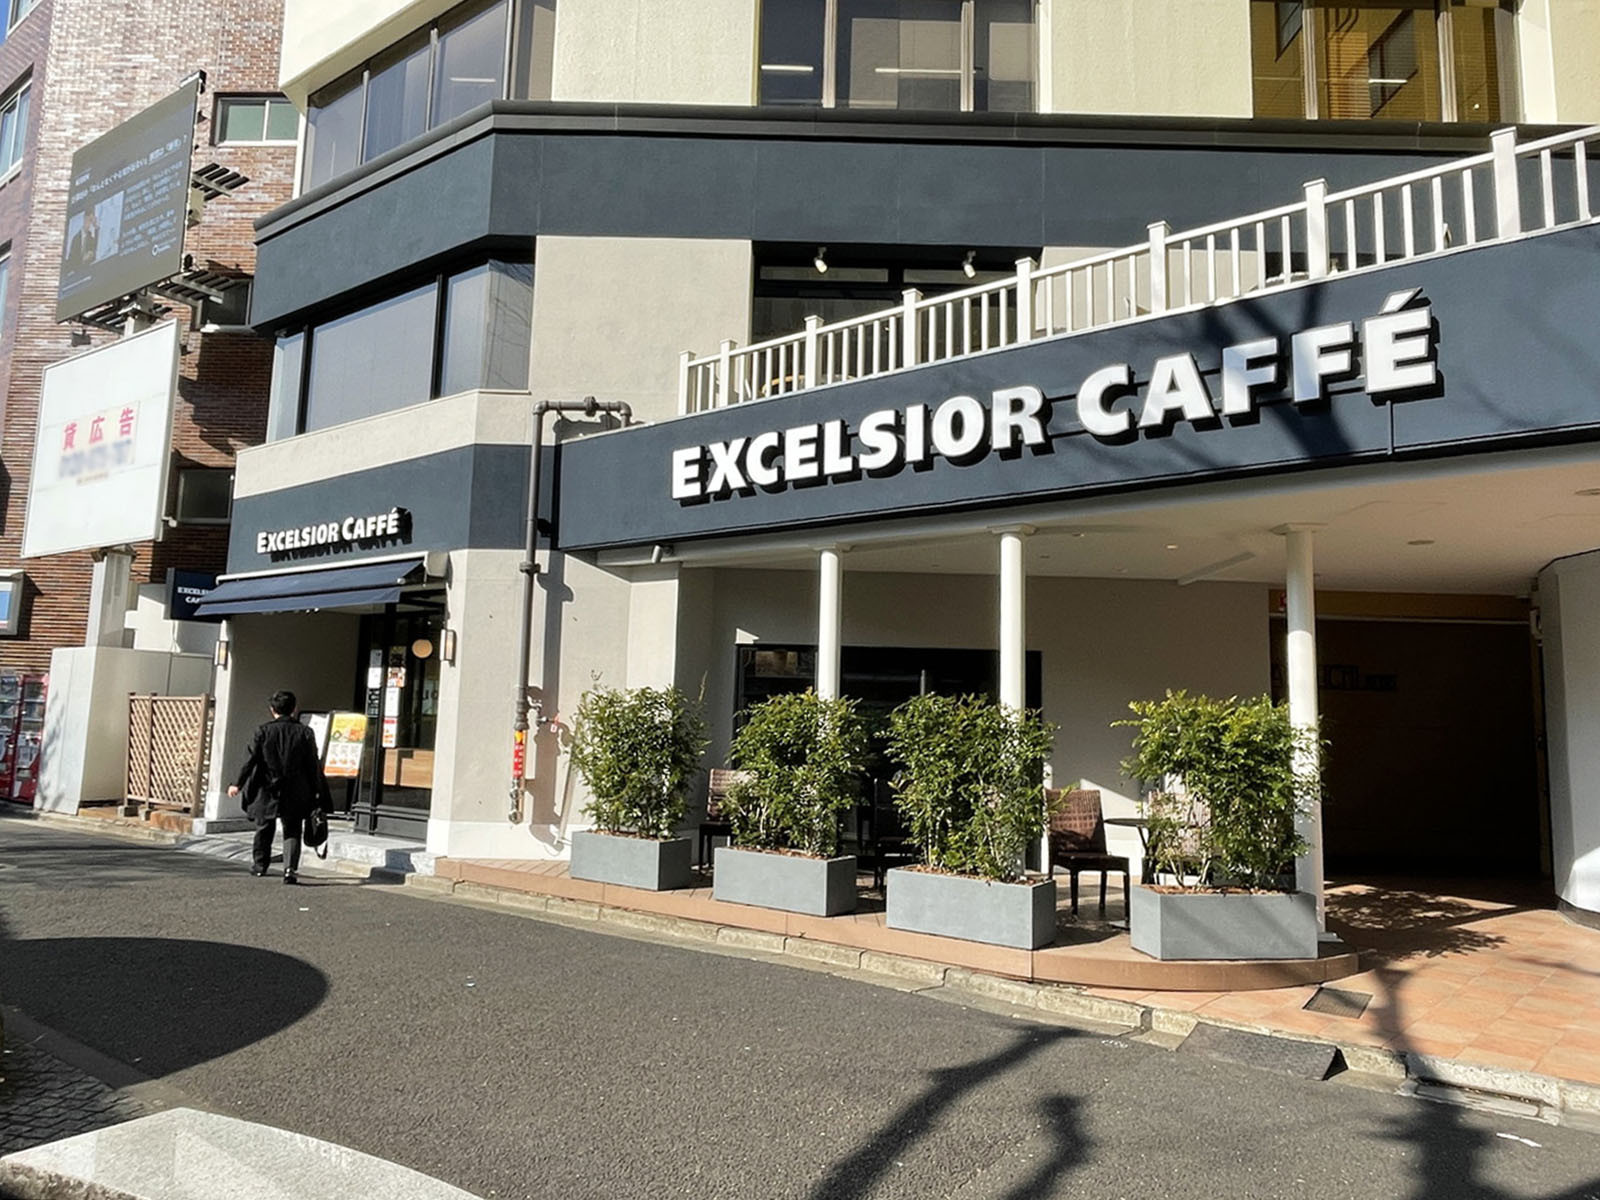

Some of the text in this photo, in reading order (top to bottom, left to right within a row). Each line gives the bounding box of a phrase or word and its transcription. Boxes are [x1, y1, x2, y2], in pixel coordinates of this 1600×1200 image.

[672, 287, 1438, 500] EXCELSIOR CAFFÉ
[256, 507, 400, 554] EXCELSIOR CAFFÉ
